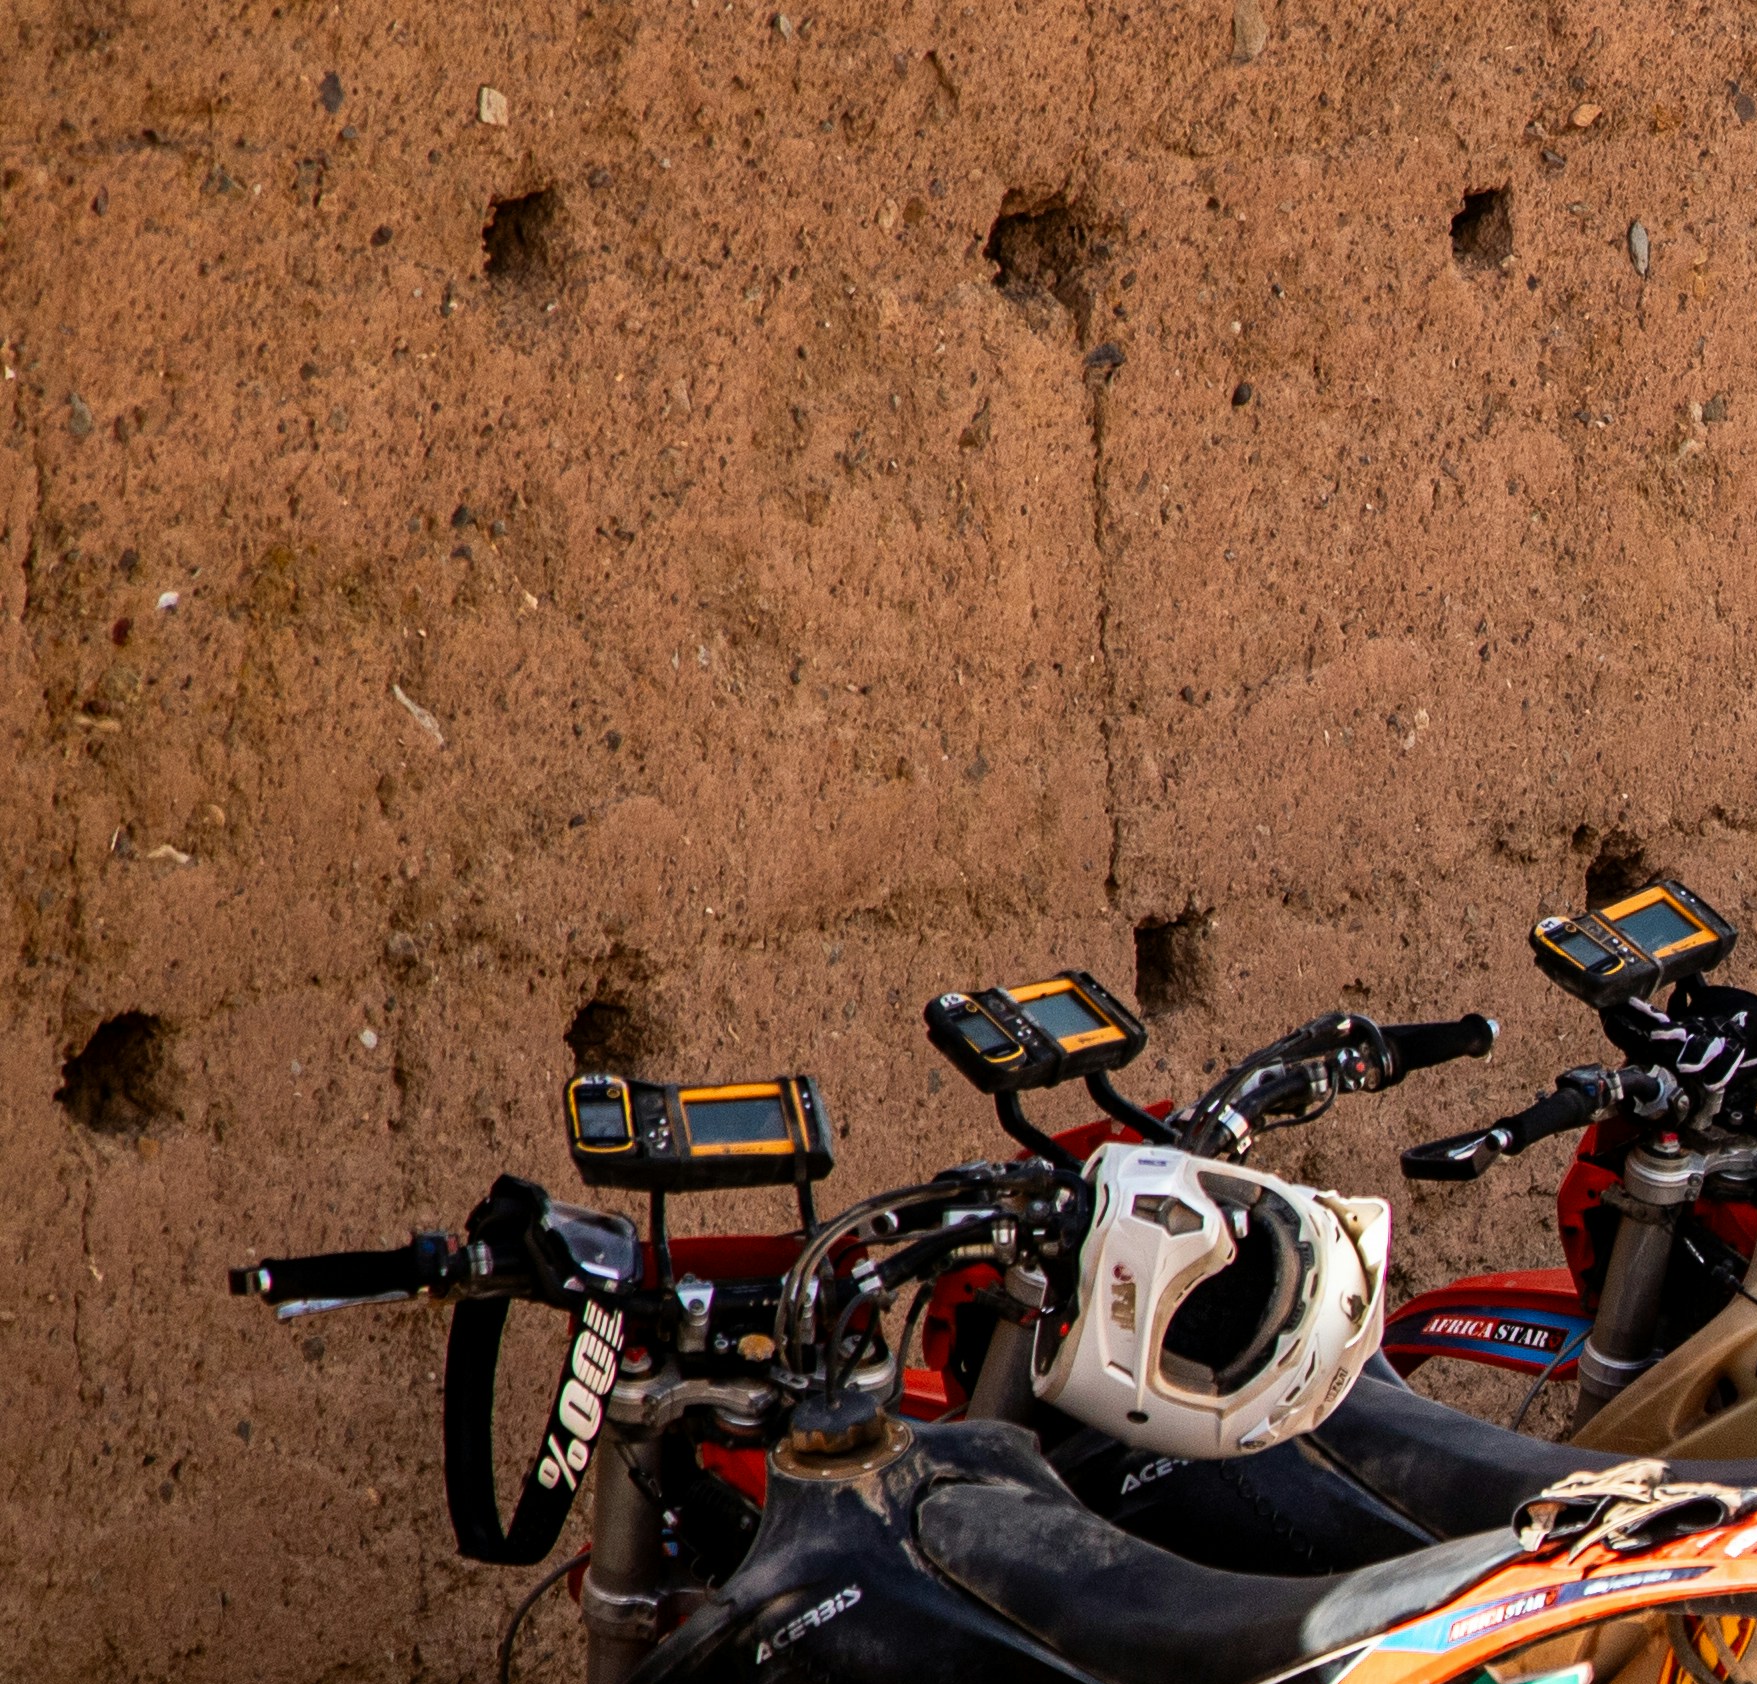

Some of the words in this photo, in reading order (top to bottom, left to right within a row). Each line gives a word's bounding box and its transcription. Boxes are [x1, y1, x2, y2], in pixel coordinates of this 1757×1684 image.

[1427, 1315, 1495, 1339] AFRICA
[1494, 1324, 1548, 1348] STAR
[538, 1299, 625, 1492] 100%
[755, 1583, 863, 1665] ACERBIS
[1504, 1593, 1547, 1620] STAR
